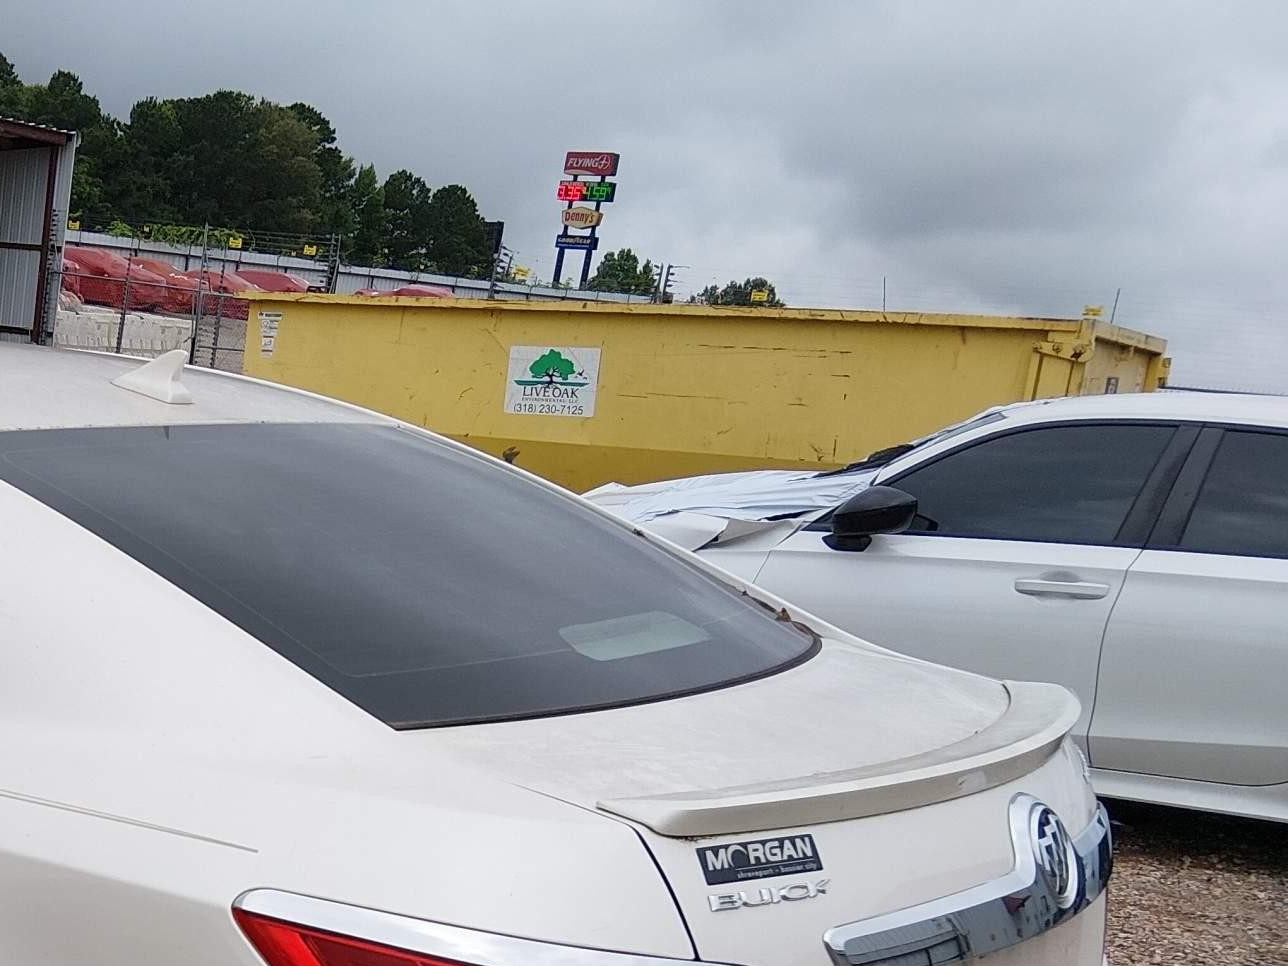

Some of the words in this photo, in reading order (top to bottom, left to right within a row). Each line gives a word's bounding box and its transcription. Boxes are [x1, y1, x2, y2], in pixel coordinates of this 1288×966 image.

[567, 157, 598, 168] FLYING
[564, 211, 595, 225] Denny's
[513, 402, 537, 414] (318)
[539, 403, 584, 416] 230-7125
[705, 837, 812, 871] MORGAN
[708, 879, 831, 912] BUICK
